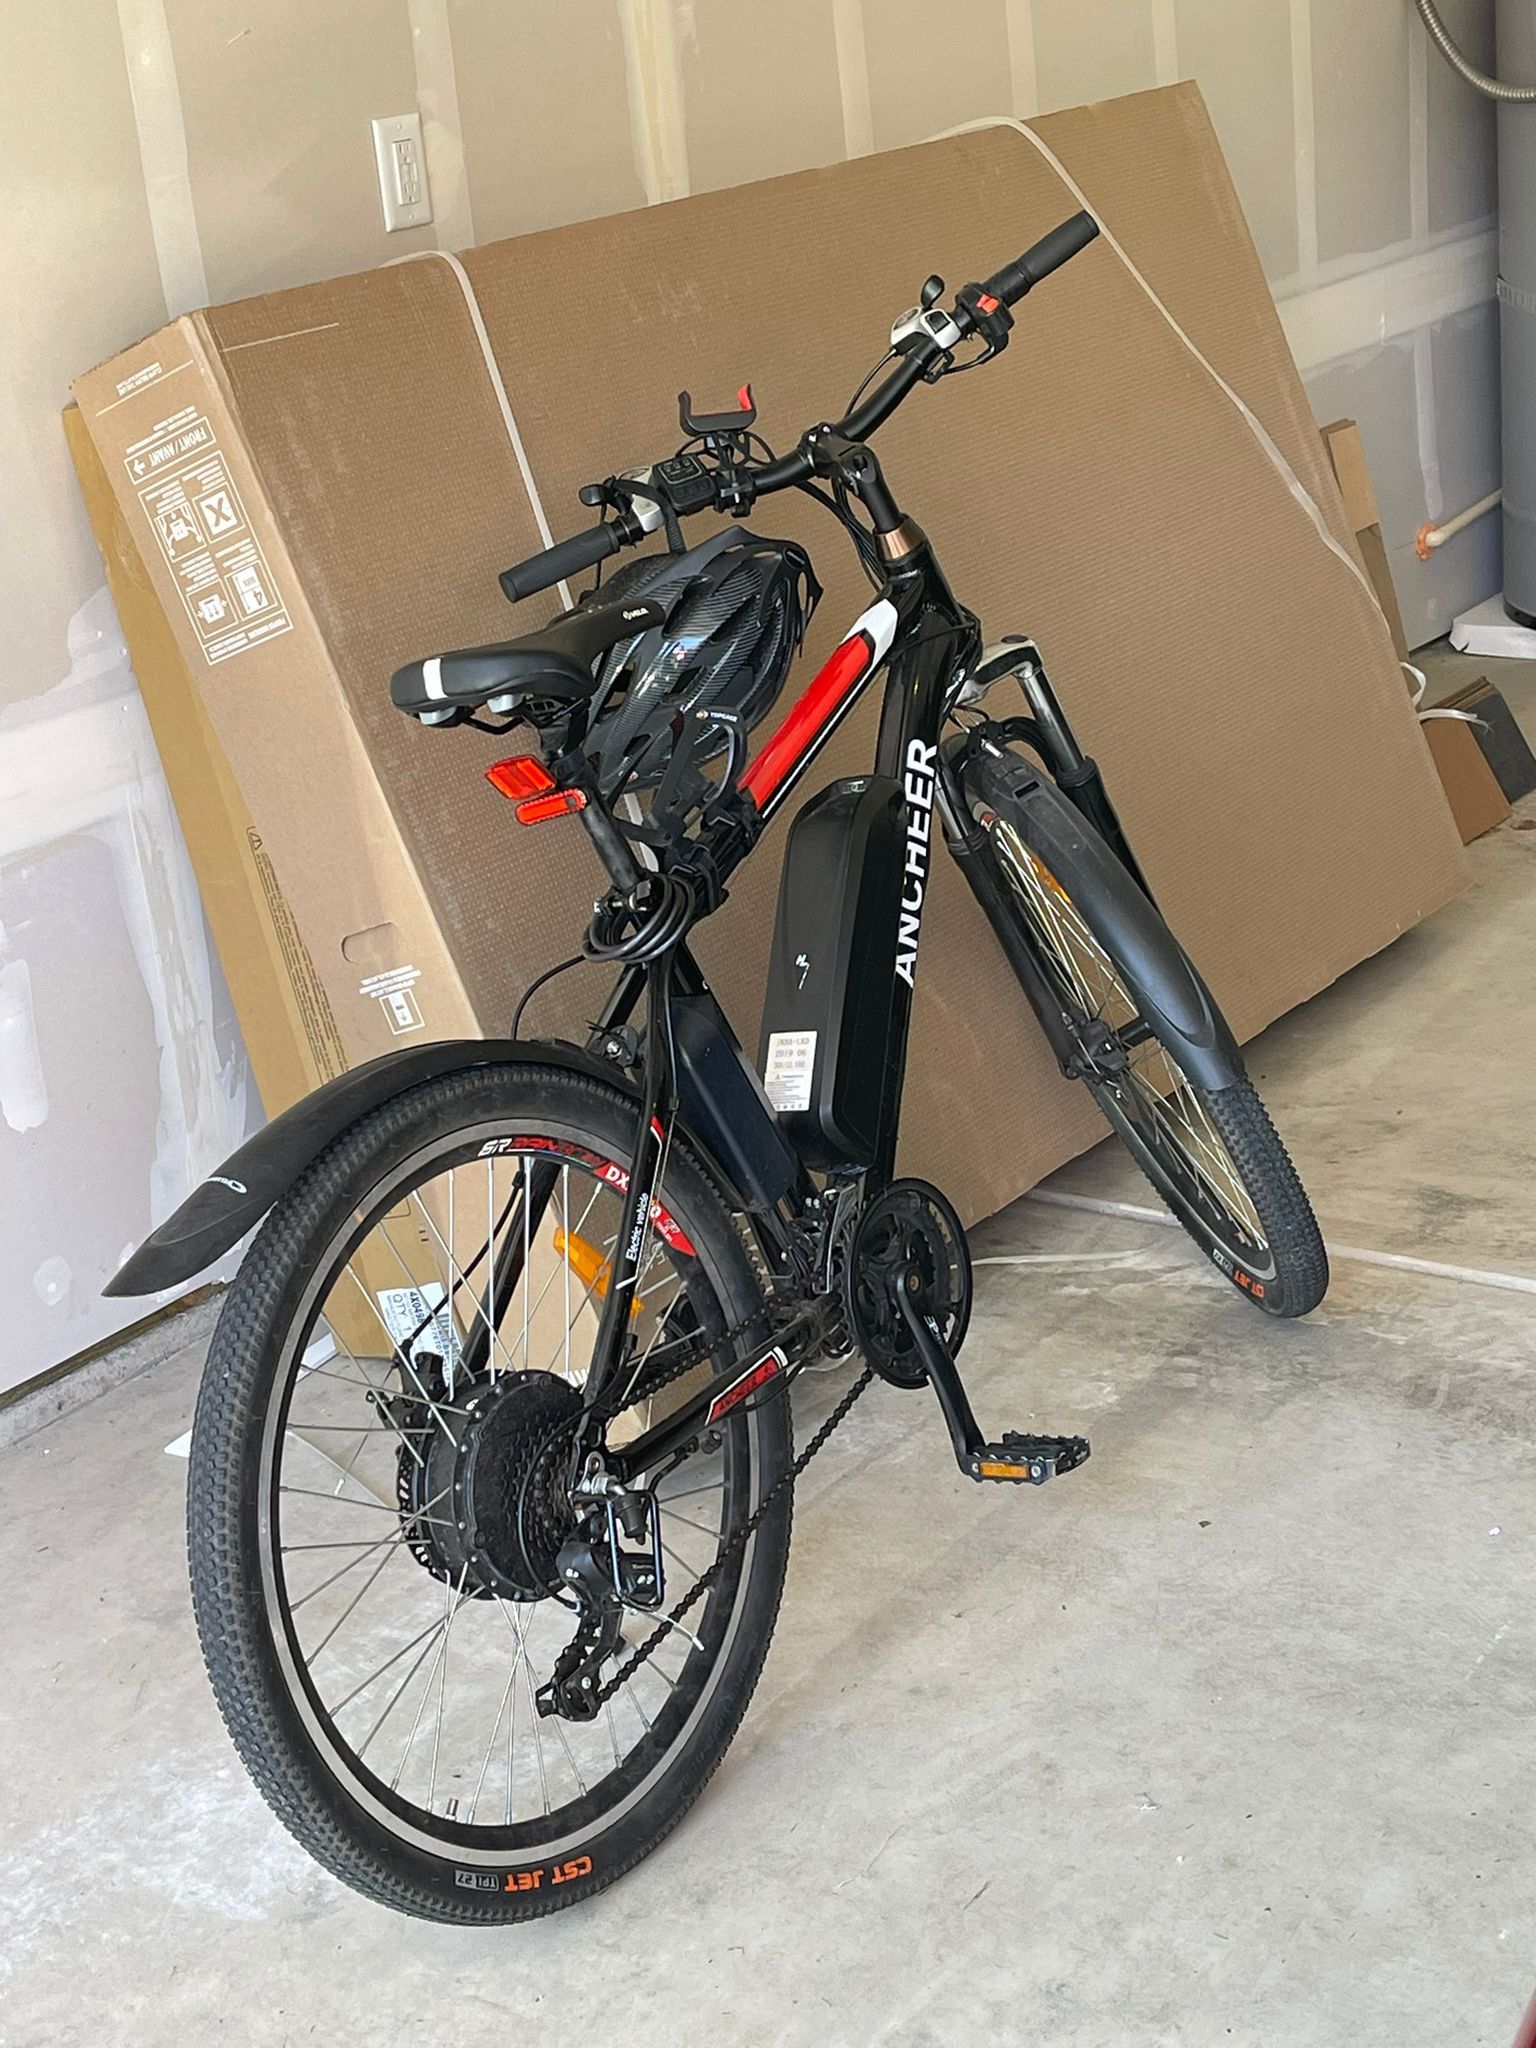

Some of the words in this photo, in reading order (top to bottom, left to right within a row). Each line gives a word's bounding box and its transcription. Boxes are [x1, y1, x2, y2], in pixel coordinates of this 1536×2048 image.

[895, 738, 937, 988] ANCHEER
[633, 1192, 649, 1228] vehicle
[625, 1226, 644, 1262] Electric
[458, 1873, 474, 1885] 27
[478, 1875, 497, 1889] TPI
[504, 1870, 544, 1892] JET
[551, 1855, 593, 1885] CST
